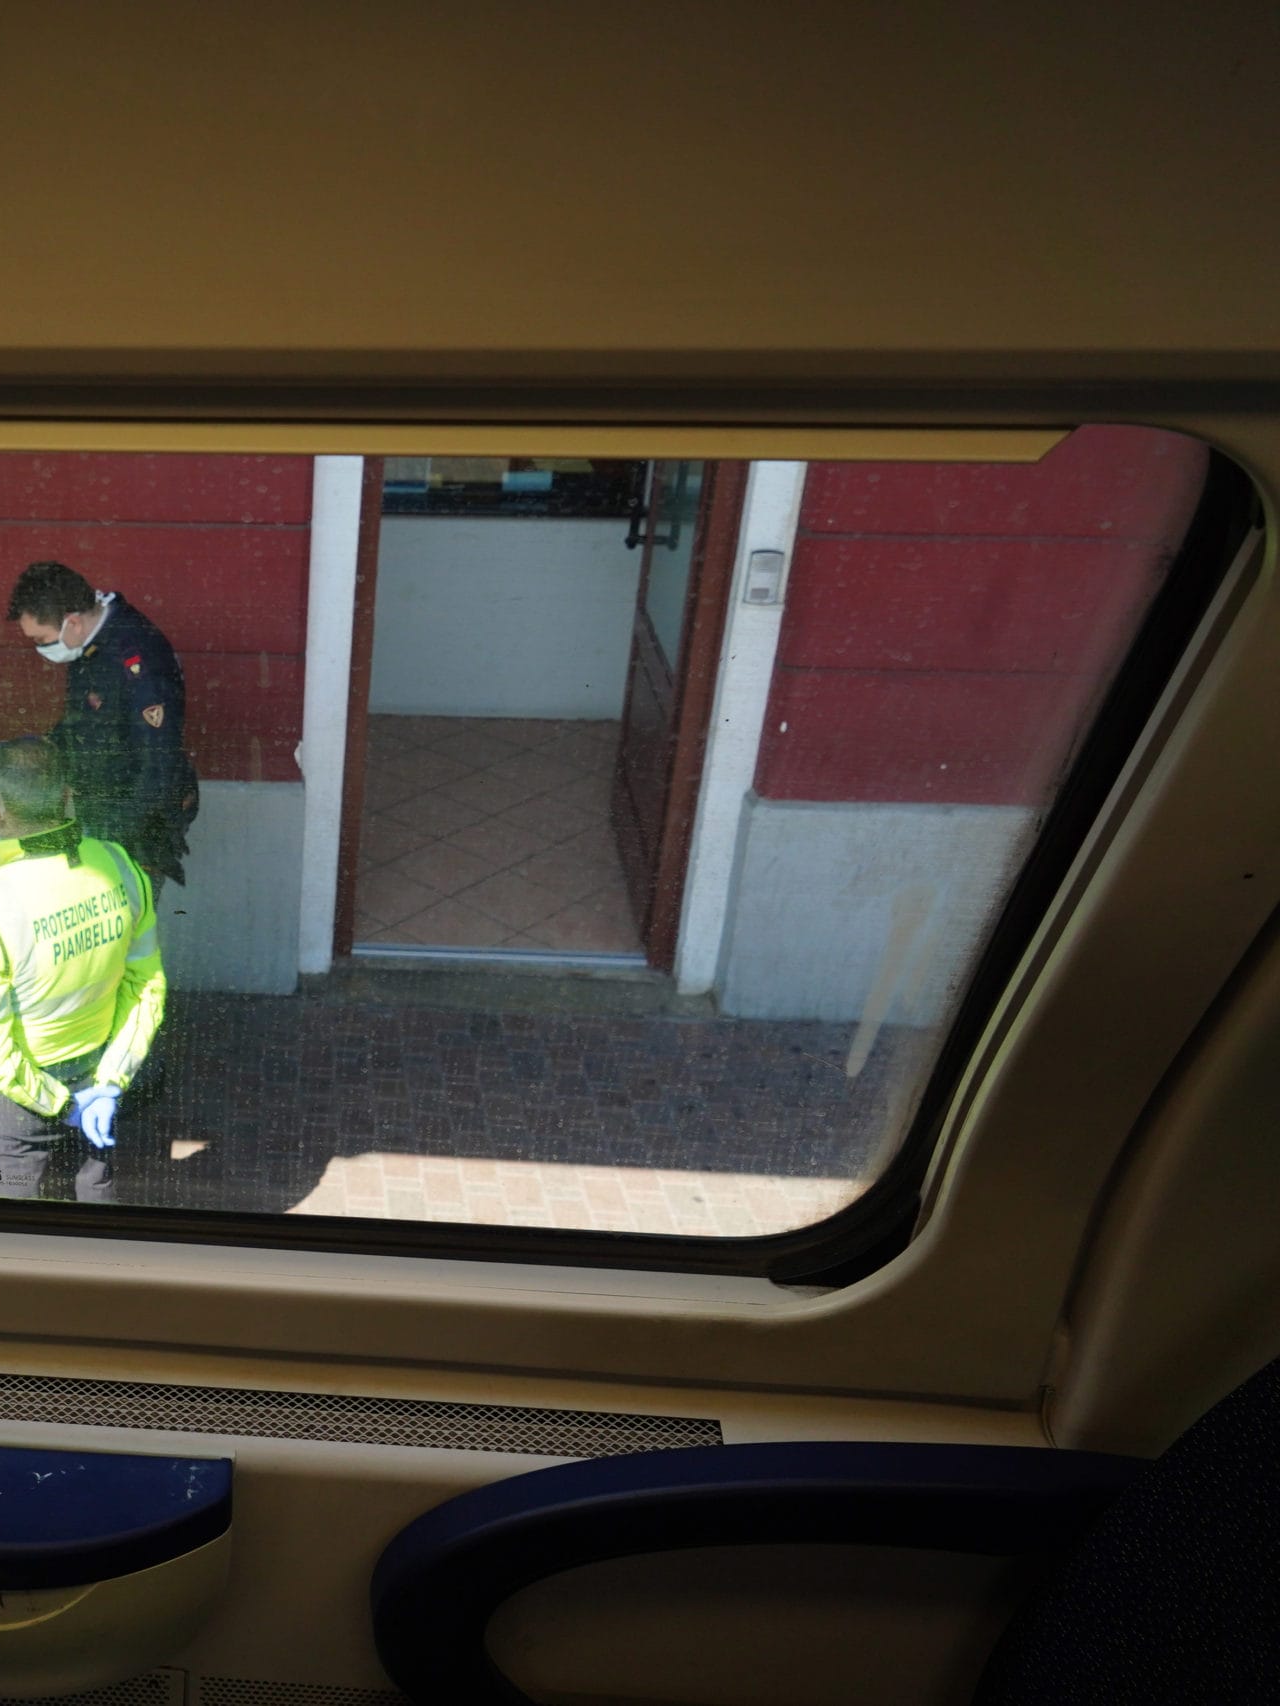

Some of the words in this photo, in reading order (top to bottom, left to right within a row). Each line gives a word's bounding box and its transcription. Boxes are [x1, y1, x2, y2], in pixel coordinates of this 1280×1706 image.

[33, 897, 99, 943] PROTEZIONE
[101, 884, 128, 913] CIVILE
[53, 915, 124, 965] PIAMBELLO
